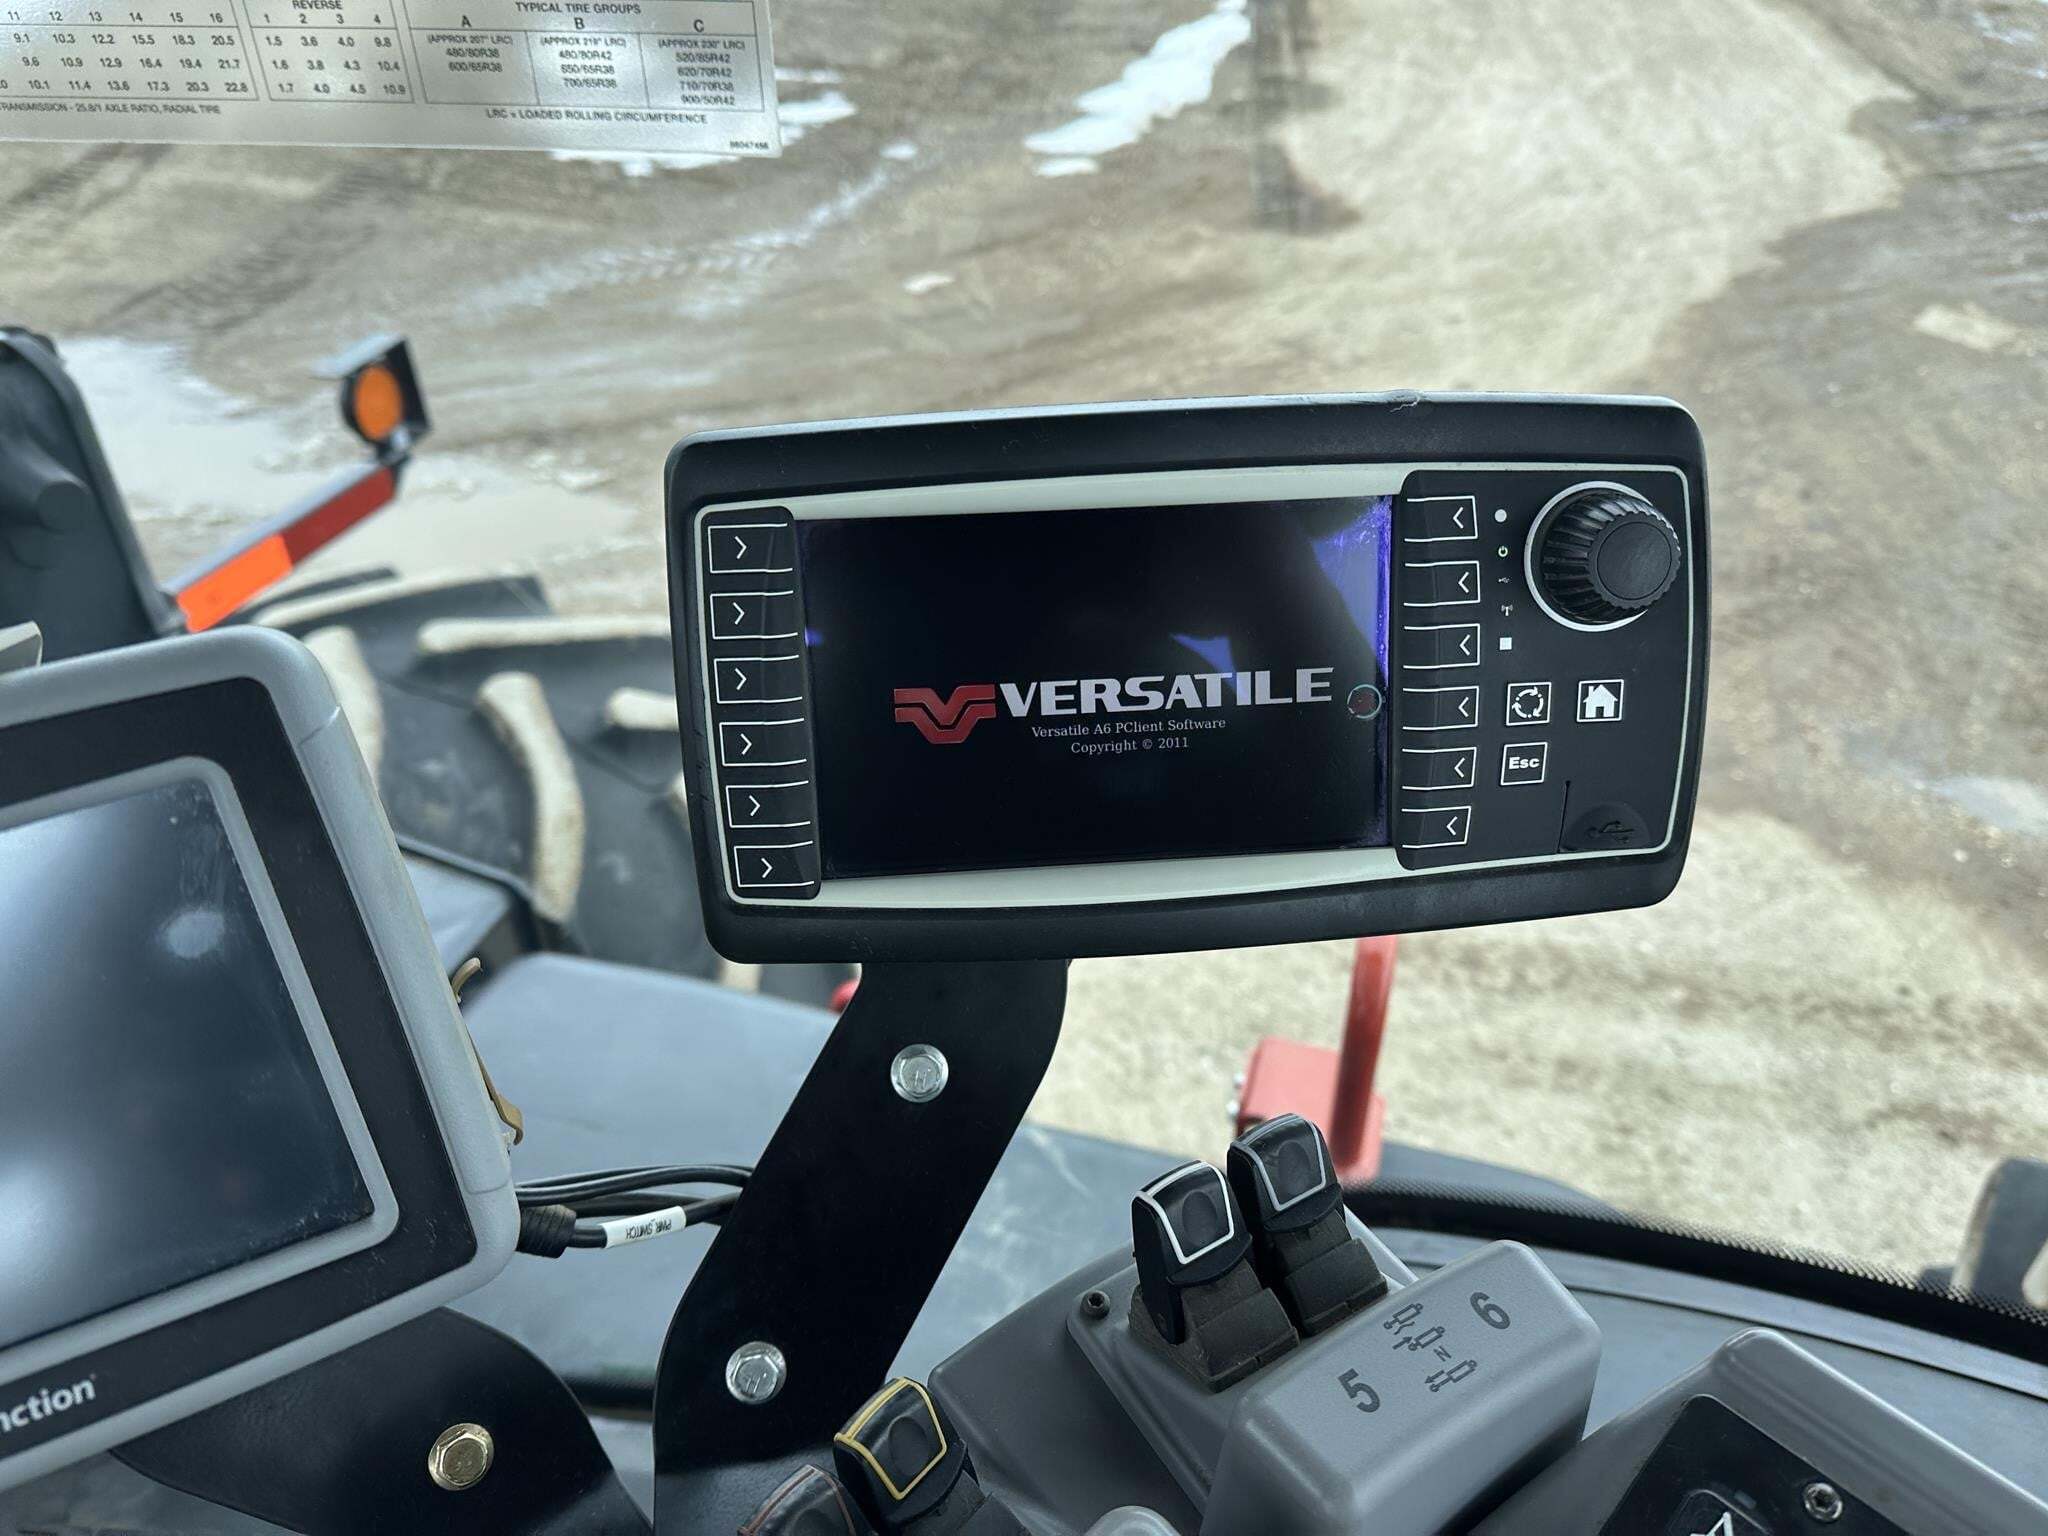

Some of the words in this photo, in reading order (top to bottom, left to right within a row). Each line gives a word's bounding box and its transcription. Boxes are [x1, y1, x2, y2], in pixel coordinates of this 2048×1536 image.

[292, 0, 343, 10] REVERSE
[515, 2, 562, 12] TYPICAL
[565, 3, 591, 13] TIRE
[593, 3, 641, 15] GROUPS
[8, 11, 20, 21] 11
[49, 11, 63, 21] 12
[89, 11, 102, 22] 13
[129, 12, 143, 22] 14
[170, 12, 183, 23] 15
[210, 13, 223, 23] 16
[264, 13, 270, 23] 1
[299, 13, 307, 24] 2
[336, 13, 344, 24] 3
[374, 14, 381, 24] 4
[462, 15, 472, 28] A
[574, 17, 585, 30] B
[692, 19, 706, 34] C
[13, 33, 30, 43] 9.1
[52, 33, 76, 44] 10.3
[92, 34, 115, 44] 12.2
[132, 34, 155, 45] 15.5
[172, 34, 196, 45] 18.3
[211, 35, 235, 46] 20.5
[265, 35, 282, 46] 1.5
[300, 36, 318, 47] 3.6
[338, 36, 355, 47] 4.0
[427, 34, 467, 44] (APPROX
[540, 36, 580, 46] (APPROX
[658, 39, 700, 49] (APPROX
[722, 40, 745, 51] LRC)
[60, 57, 83, 68] 10.9
[100, 57, 122, 68] 12.9
[139, 58, 162, 68] 16.4
[179, 58, 202, 69] 19.4
[218, 59, 240, 69] 21.7
[344, 60, 360, 70] 4.3
[377, 61, 400, 71] 10.4
[28, 79, 50, 90] 10.1
[68, 81, 91, 90] 11.4
[147, 81, 170, 92] 17.3
[186, 81, 210, 92] 20.3
[278, 82, 293, 93] 1.7
[105, 103, 131, 113] AXLE
[486, 108, 508, 119] LRC
[519, 109, 562, 120] LOADED
[564, 110, 612, 121] ROLLING
[614, 112, 707, 124] CIRCUMFERENCE
[1000, 667, 1334, 717] VERSATILE
[1031, 724, 1090, 737] Versatile
[1092, 722, 1112, 735] A6
[1115, 720, 1164, 734] PClient
[1167, 717, 1227, 731] Software
[1070, 740, 1138, 755] Copyright
[1141, 738, 1153, 750] ©
[1157, 736, 1189, 750] 2011
[1508, 757, 1540, 770] Esc
[1470, 1292, 1511, 1330] 6
[1337, 1368, 1381, 1413] 5
